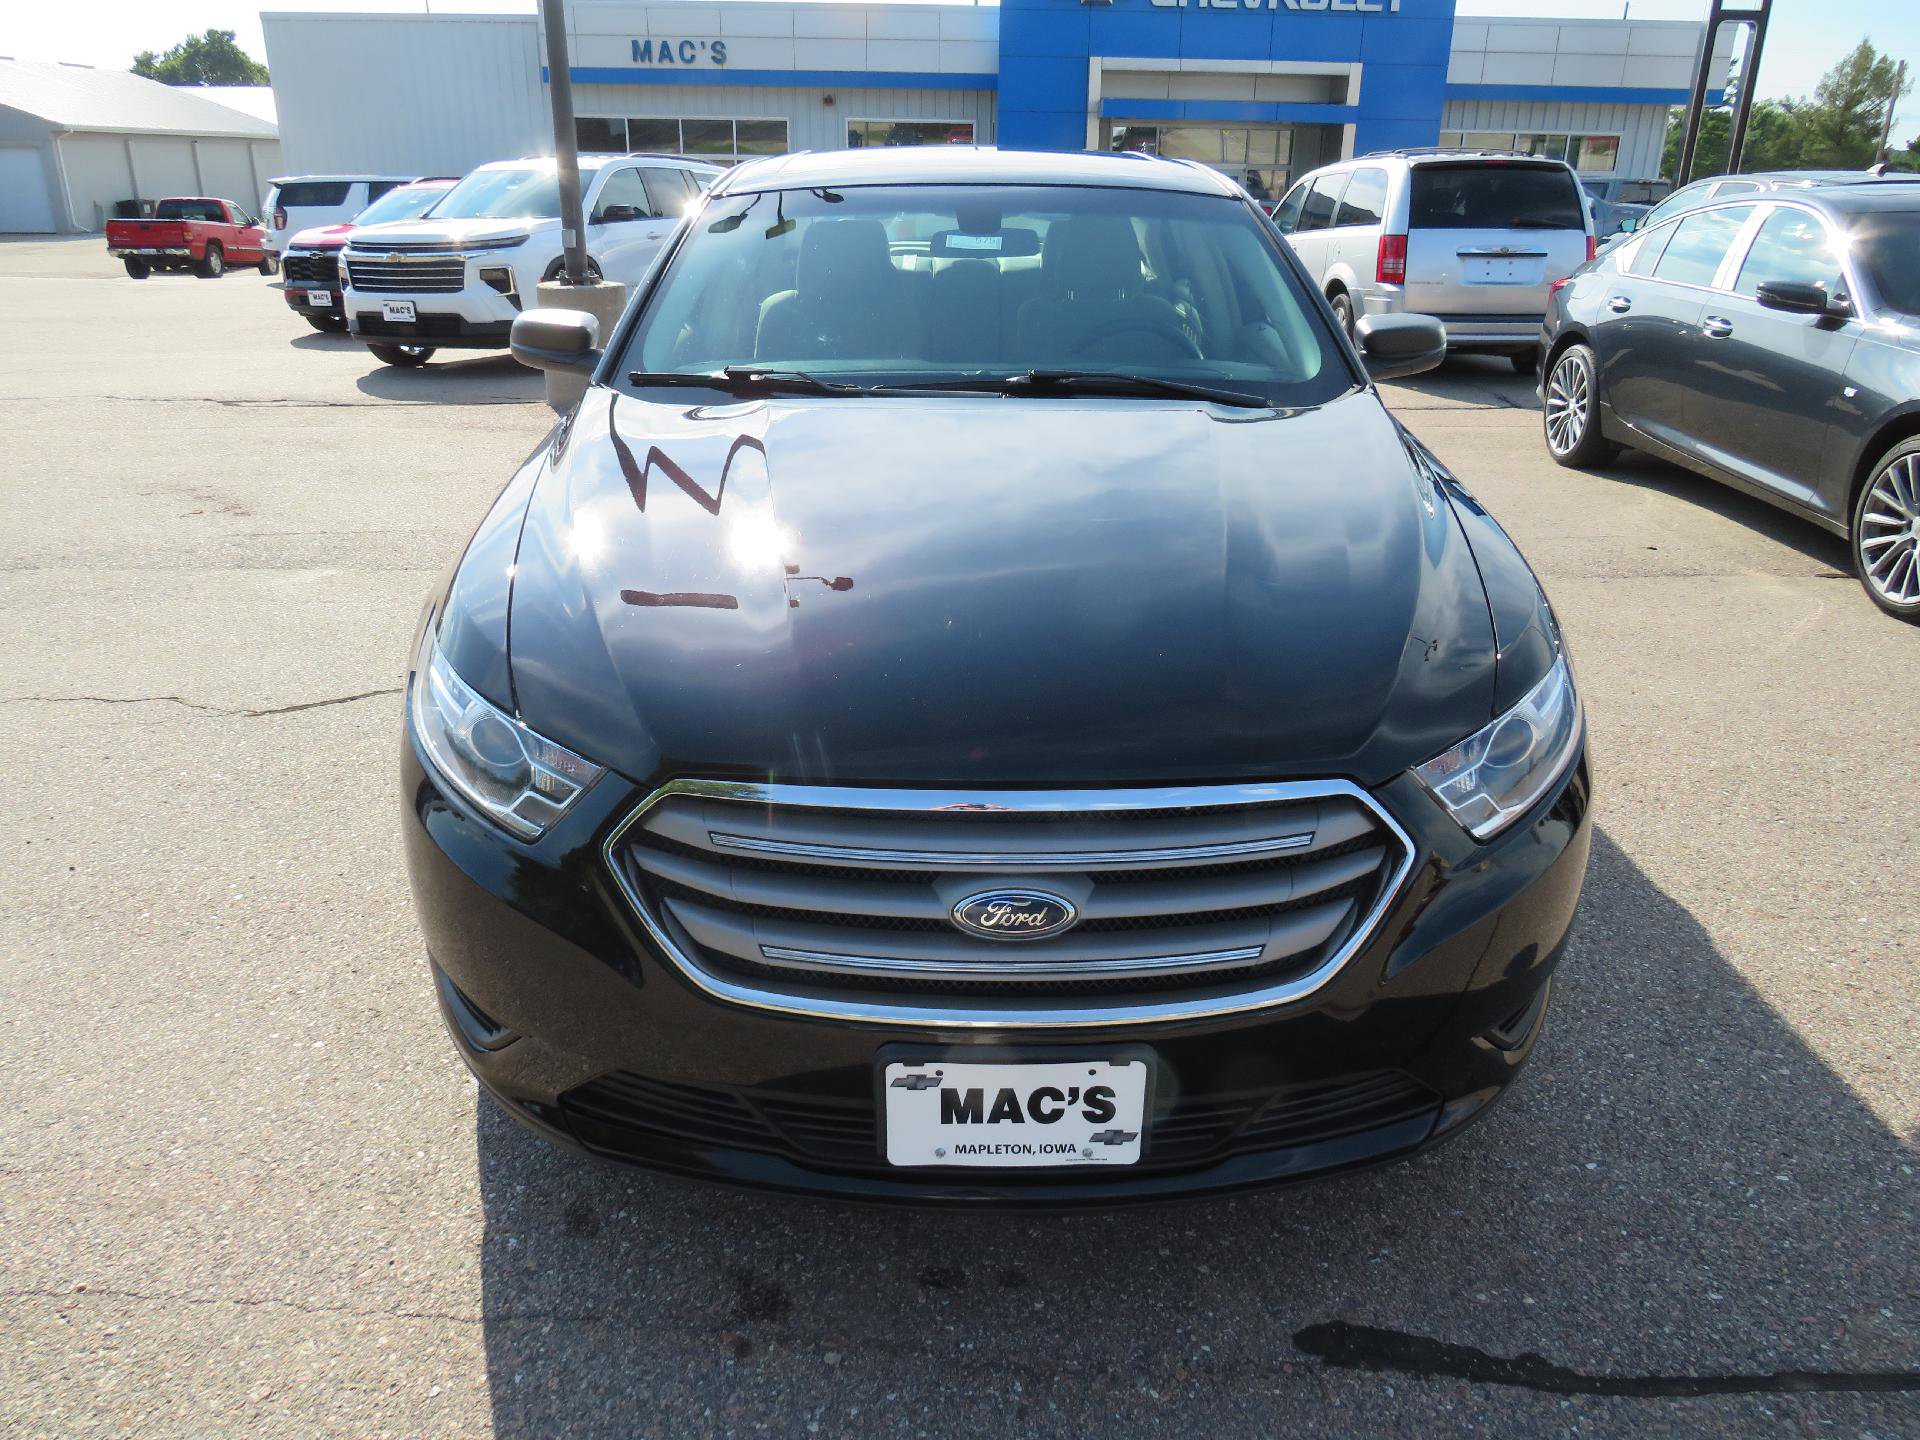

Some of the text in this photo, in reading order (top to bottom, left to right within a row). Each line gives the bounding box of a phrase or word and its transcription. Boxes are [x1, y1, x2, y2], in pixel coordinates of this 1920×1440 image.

[631, 39, 728, 65] MAC'S
[389, 306, 412, 315] MAC'S
[980, 900, 1048, 927] Ford
[940, 1085, 1117, 1125] MAC'S
[954, 1143, 1077, 1158] MAPLETON, IOWA
